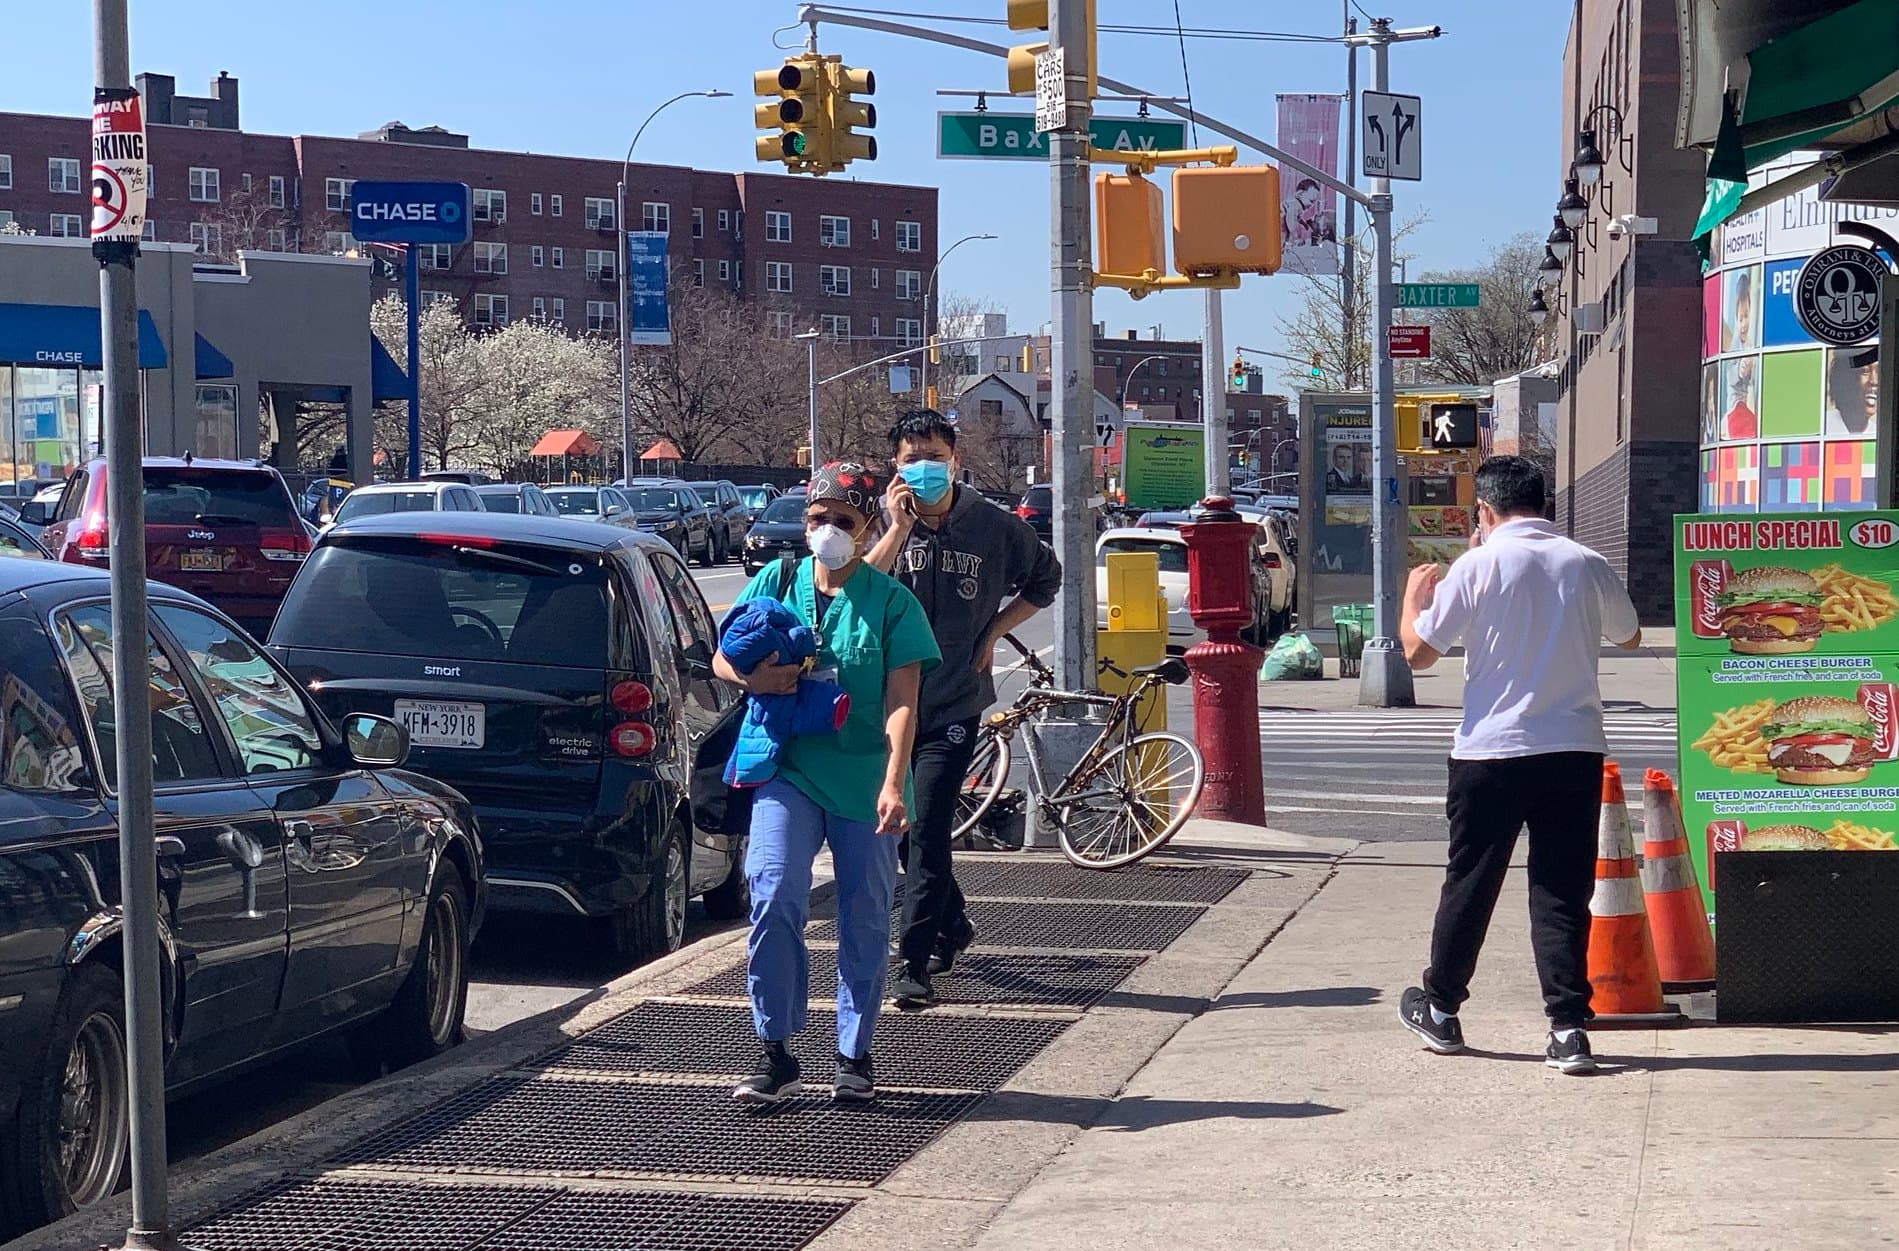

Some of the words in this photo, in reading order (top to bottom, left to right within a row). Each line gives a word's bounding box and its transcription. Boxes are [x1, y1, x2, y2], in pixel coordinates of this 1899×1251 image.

[1037, 60, 1062, 80] CARS
[1043, 78, 1063, 100] $500
[1046, 101, 1057, 113] 516
[1365, 155, 1386, 169] ONLY
[357, 203, 437, 220] CHASE
[1726, 231, 1763, 254] HOSPITALS
[1804, 250, 1849, 289] OMRANI
[1851, 251, 1861, 261] &
[1398, 286, 1457, 305] BAXTER
[1465, 287, 1478, 296] AV
[1807, 308, 1856, 340] Attorneys
[36, 350, 83, 362] CHASE
[335, 488, 343, 498] P
[187, 530, 215, 541] Jeep
[1683, 521, 1753, 551] LUNCH
[1757, 519, 1843, 550] SPECIAL
[1857, 522, 1892, 546] $10
[1723, 660, 1765, 669] BACON
[1769, 659, 1817, 668] CHEESE
[1821, 658, 1871, 667] BURGER
[424, 665, 461, 676] smart
[1714, 673, 1743, 682] Served
[1745, 673, 1761, 681] with
[1764, 672, 1793, 681] French
[1795, 671, 1812, 681] fries
[1815, 672, 1831, 680] and
[1861, 671, 1880, 680] soda
[418, 703, 437, 712] NEW
[440, 704, 462, 713] YORK
[548, 738, 593, 747] electric
[561, 747, 589, 756] drive
[1697, 791, 1740, 800] MELTED
[1743, 790, 1810, 799] MOZARELLA
[1814, 789, 1857, 798] CHEESE
[1714, 805, 1745, 813] Served
[1748, 804, 1766, 812] with
[1769, 803, 1799, 812] French
[1802, 803, 1821, 811] fries
[1825, 802, 1841, 811] and
[1873, 802, 1895, 810] soda
